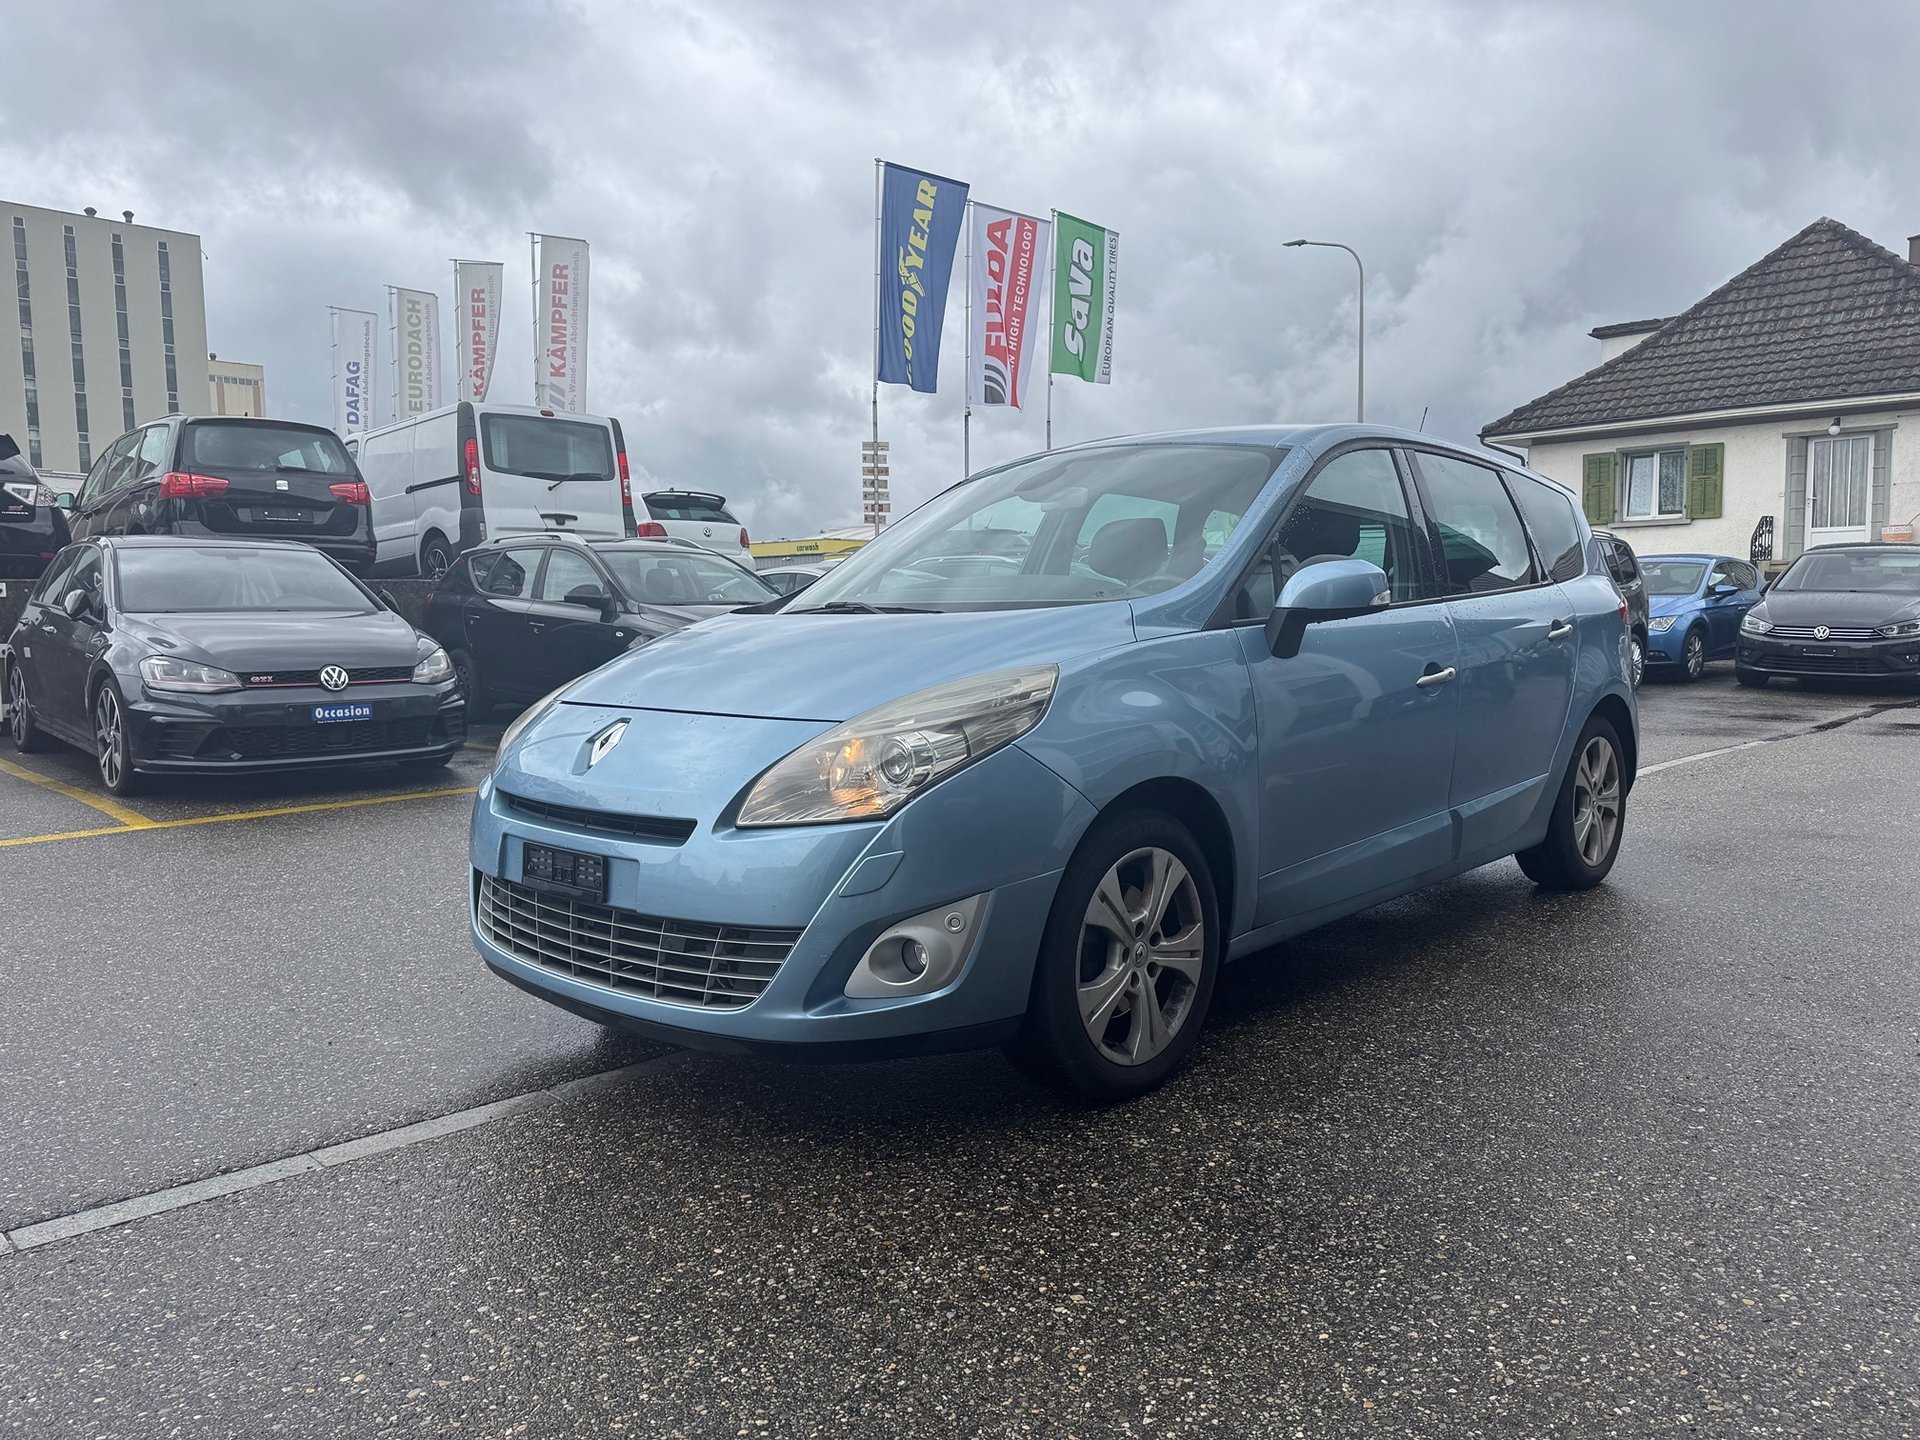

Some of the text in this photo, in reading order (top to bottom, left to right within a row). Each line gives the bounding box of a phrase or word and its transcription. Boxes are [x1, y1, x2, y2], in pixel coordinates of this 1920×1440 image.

[570, 251, 580, 343] Abdichtungstechnik
[902, 179, 938, 385] OODYEAR
[985, 217, 1013, 368] FULDA
[1013, 222, 1033, 312] TECHNOLOGY
[1102, 237, 1117, 376] EUROPEAN QUALITY TIRES
[407, 299, 423, 413] EURODACH
[469, 288, 486, 396] KÄMPFER
[547, 263, 568, 378] KÄMPFER
[570, 344, 578, 363] und
[1008, 317, 1021, 351] HIGH
[346, 361, 361, 425] DAFAG
[796, 542, 819, 551] carwash
[315, 705, 370, 719] Occasion
